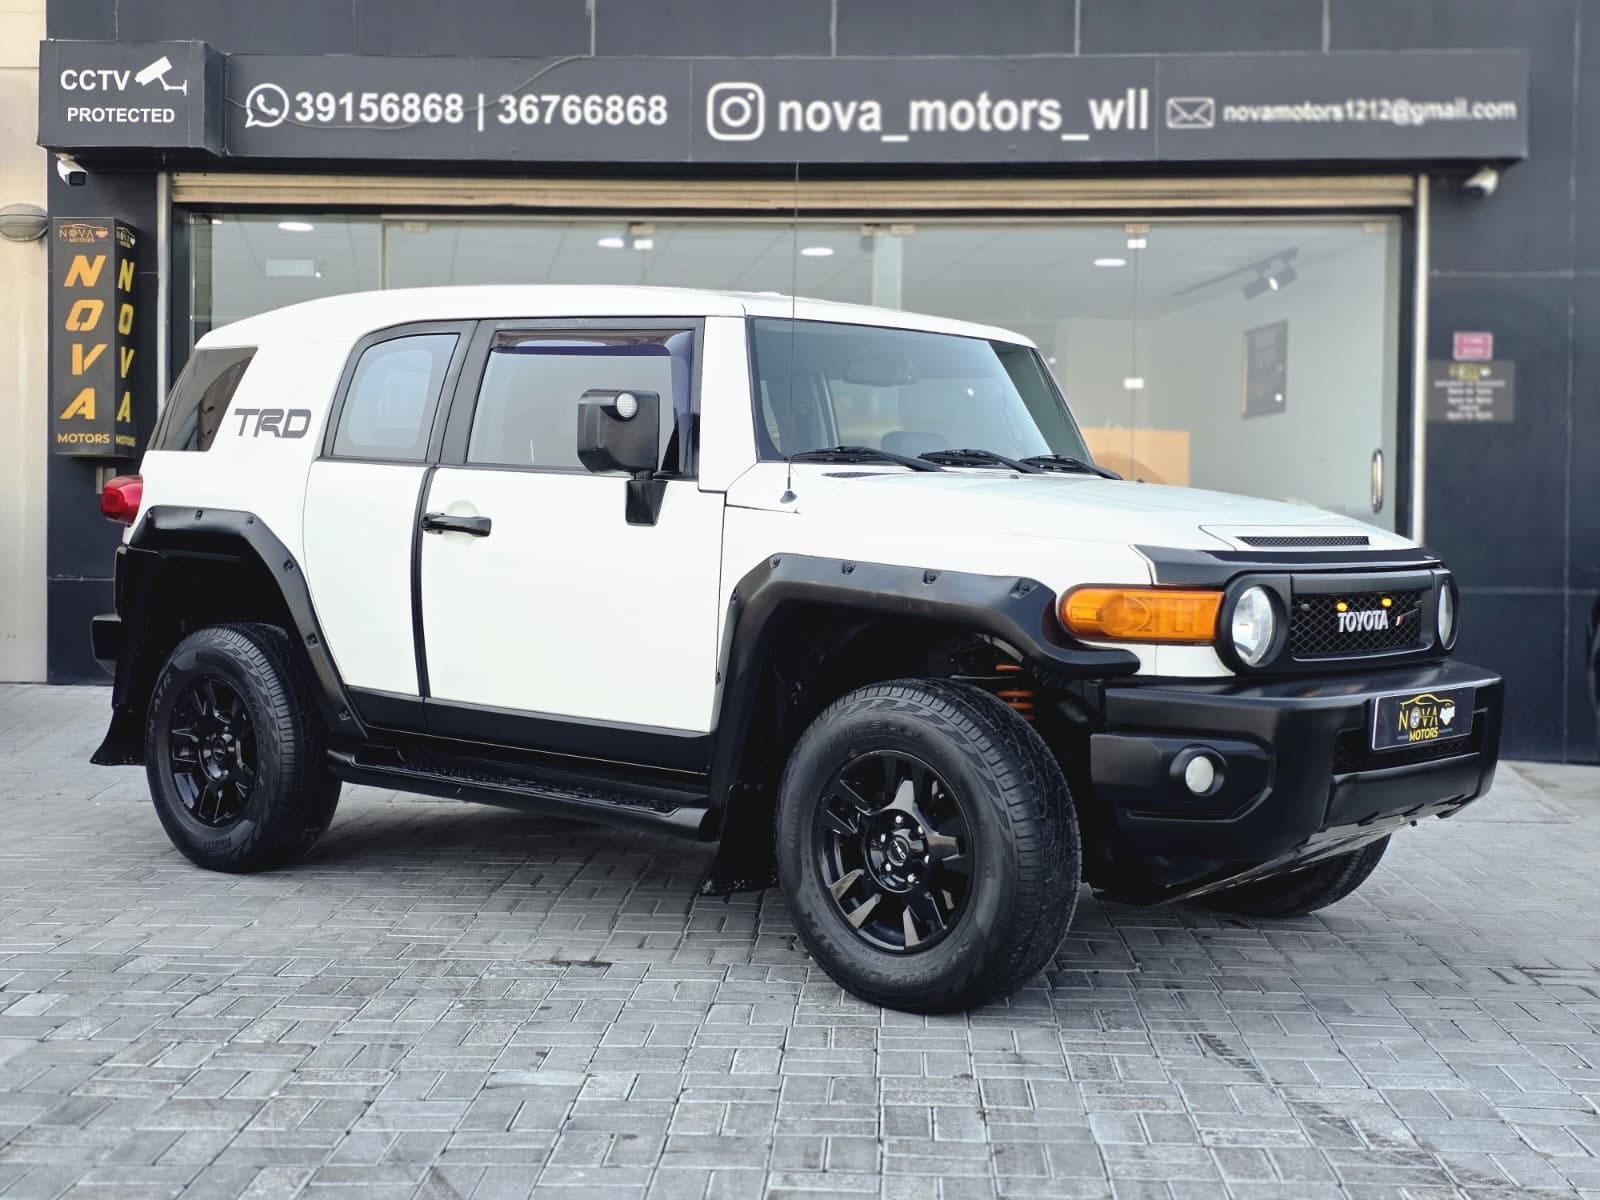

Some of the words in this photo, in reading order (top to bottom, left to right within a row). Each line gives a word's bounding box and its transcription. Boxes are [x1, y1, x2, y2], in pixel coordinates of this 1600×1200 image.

[60, 69, 131, 92] CCTV
[67, 107, 176, 123] PROTECTED
[294, 91, 464, 123] 39156868
[497, 94, 668, 126] 36766868
[778, 87, 1149, 142] nova_motors_wll
[1223, 98, 1517, 125] novamotors1212@gmail.com
[234, 408, 312, 439] TRD
[57, 433, 110, 443] MOTORS
[1338, 610, 1388, 632] TOYOTA
[1408, 727, 1439, 741] MOTORS
